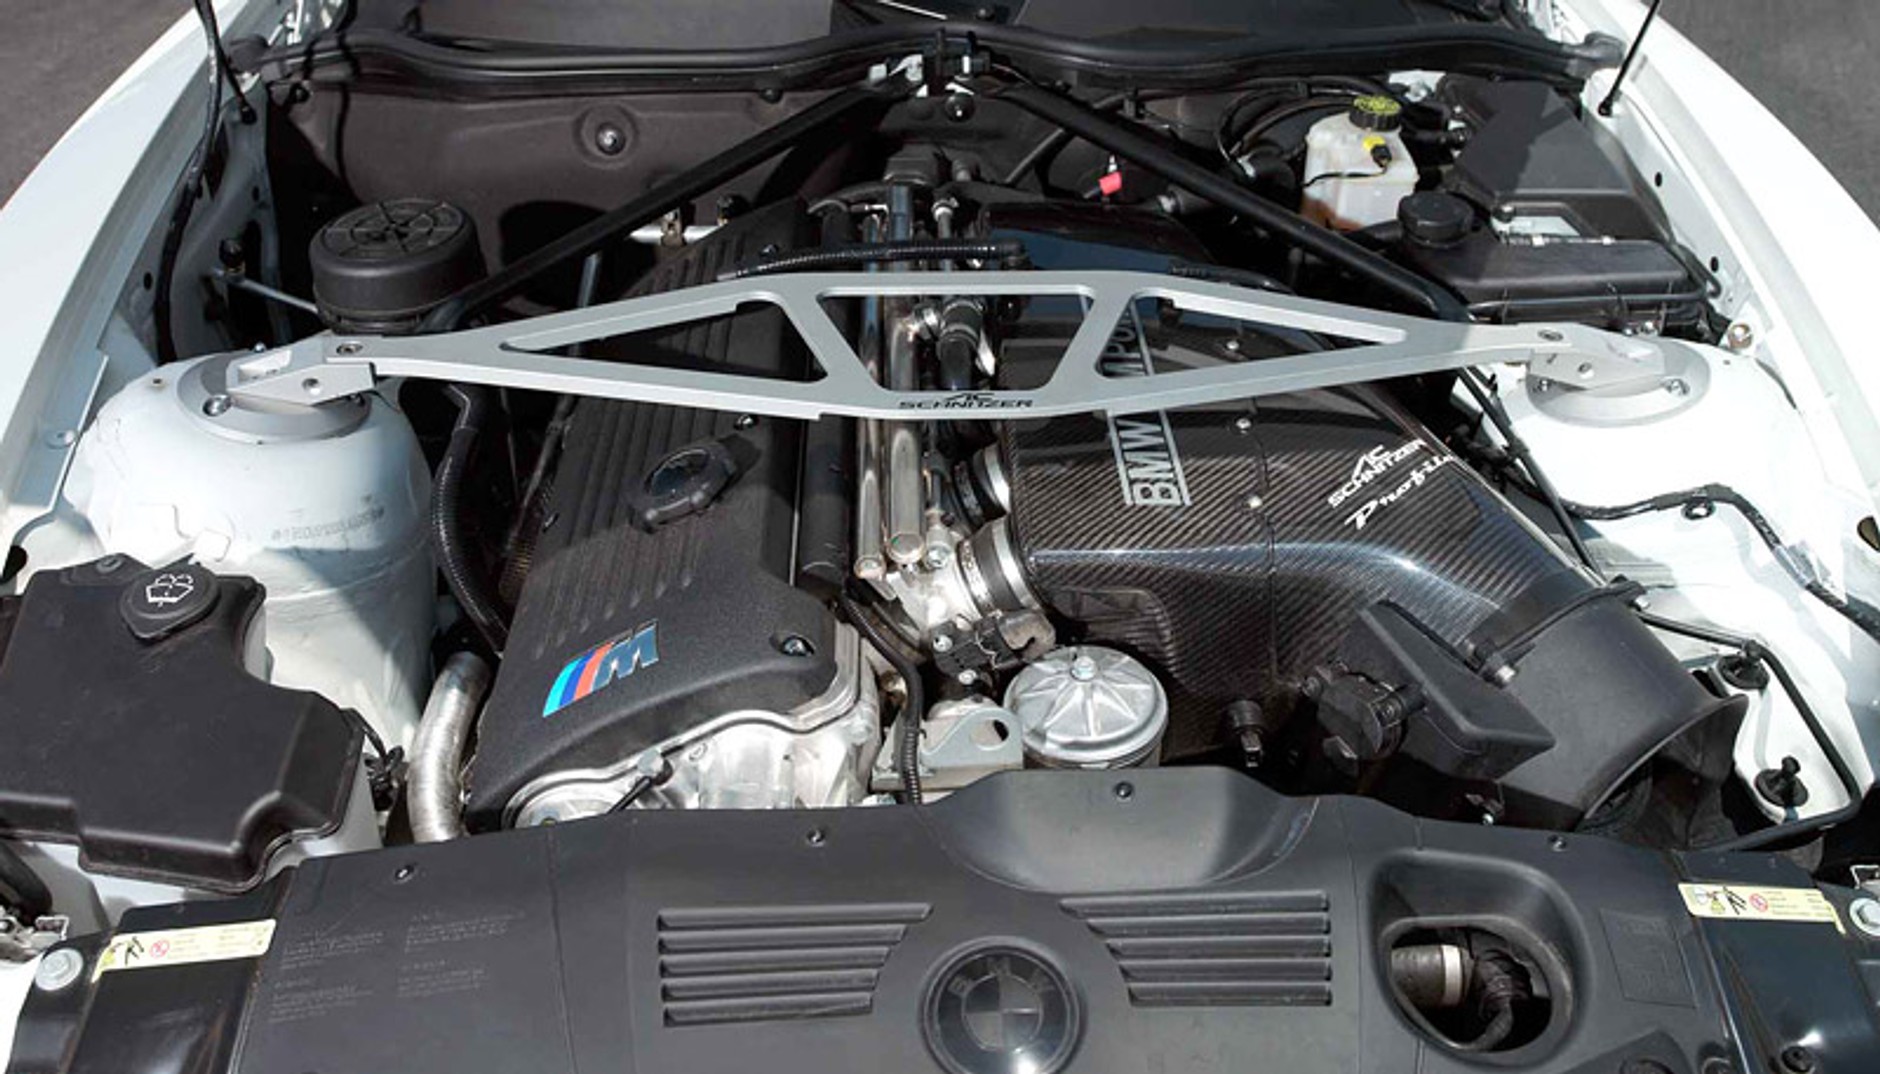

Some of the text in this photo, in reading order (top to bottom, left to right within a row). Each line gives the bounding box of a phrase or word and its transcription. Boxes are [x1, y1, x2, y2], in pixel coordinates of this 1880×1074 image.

[899, 400, 1034, 410] SCHNITZER
[1115, 419, 1182, 506] BMW
[948, 956, 1056, 997] BMW
